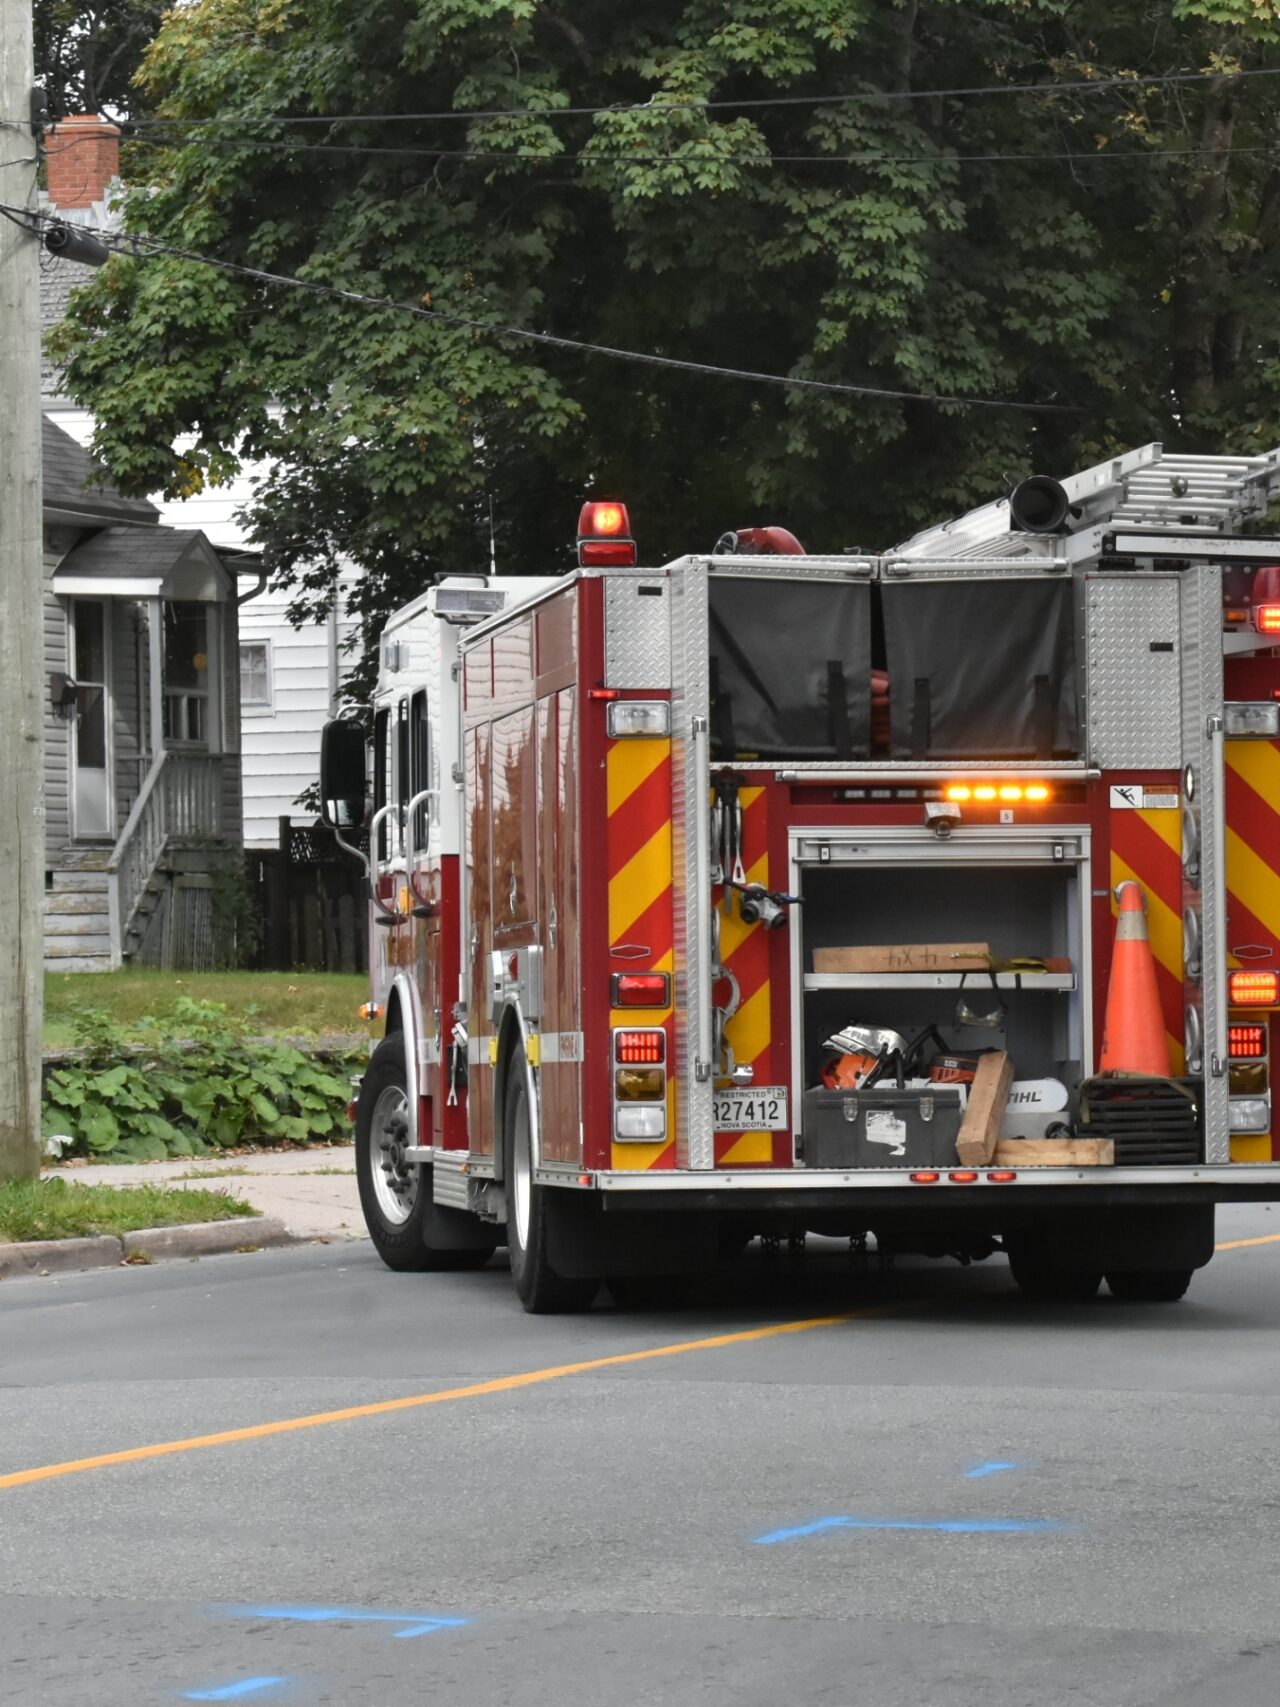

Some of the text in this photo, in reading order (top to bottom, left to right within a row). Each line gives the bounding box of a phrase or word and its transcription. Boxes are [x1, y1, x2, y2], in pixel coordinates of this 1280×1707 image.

[720, 1091, 766, 1099] RESTRICTED
[1008, 1091, 1042, 1104] TIHL
[742, 1121, 767, 1129] SCOTIA
